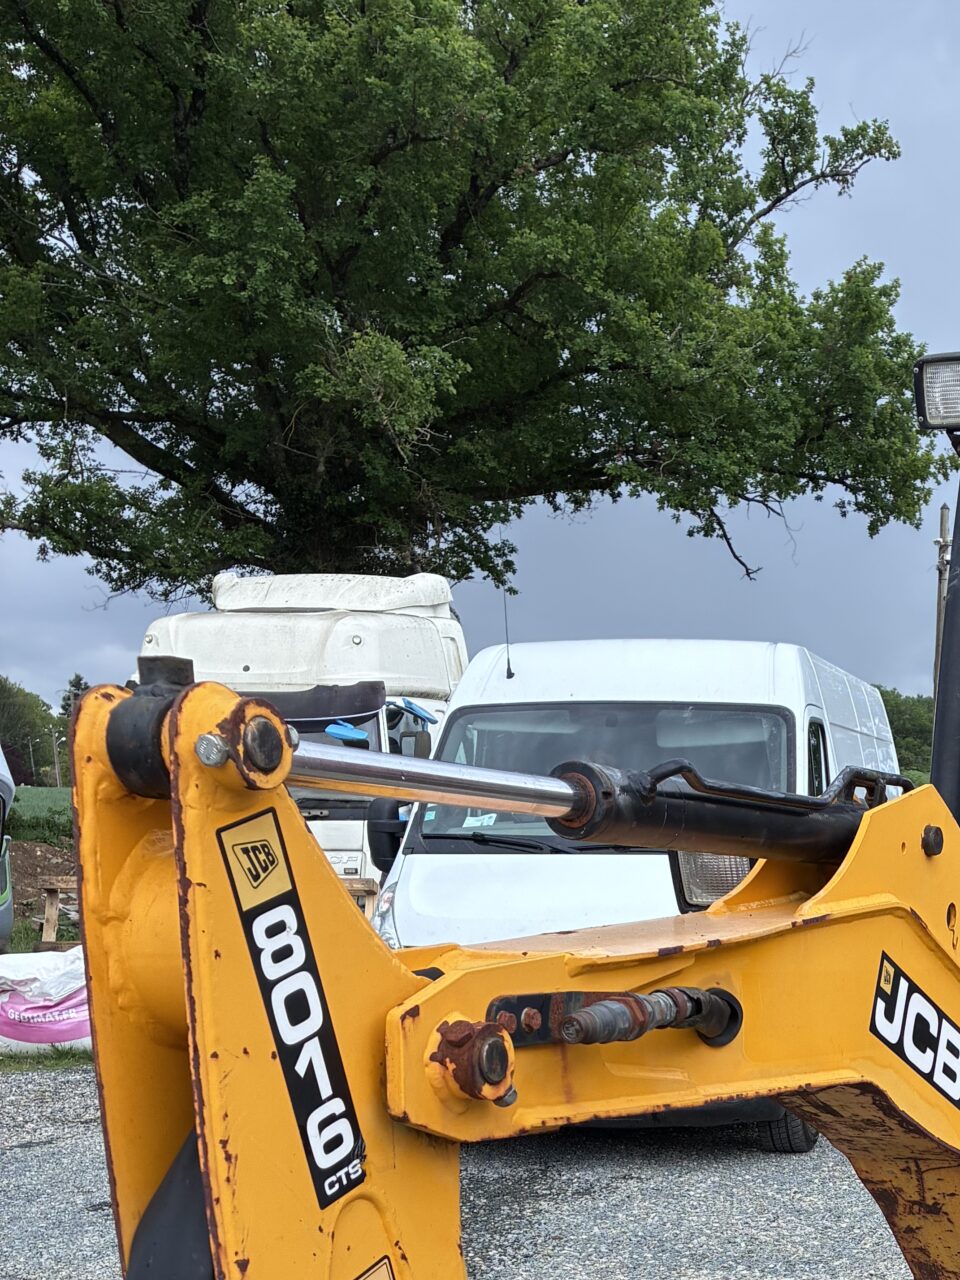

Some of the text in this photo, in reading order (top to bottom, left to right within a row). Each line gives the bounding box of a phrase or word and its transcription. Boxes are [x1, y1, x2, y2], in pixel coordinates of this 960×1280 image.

[240, 843, 276, 882] JCB
[252, 904, 354, 1170] 8016
[324, 1158, 363, 1197] CTS
